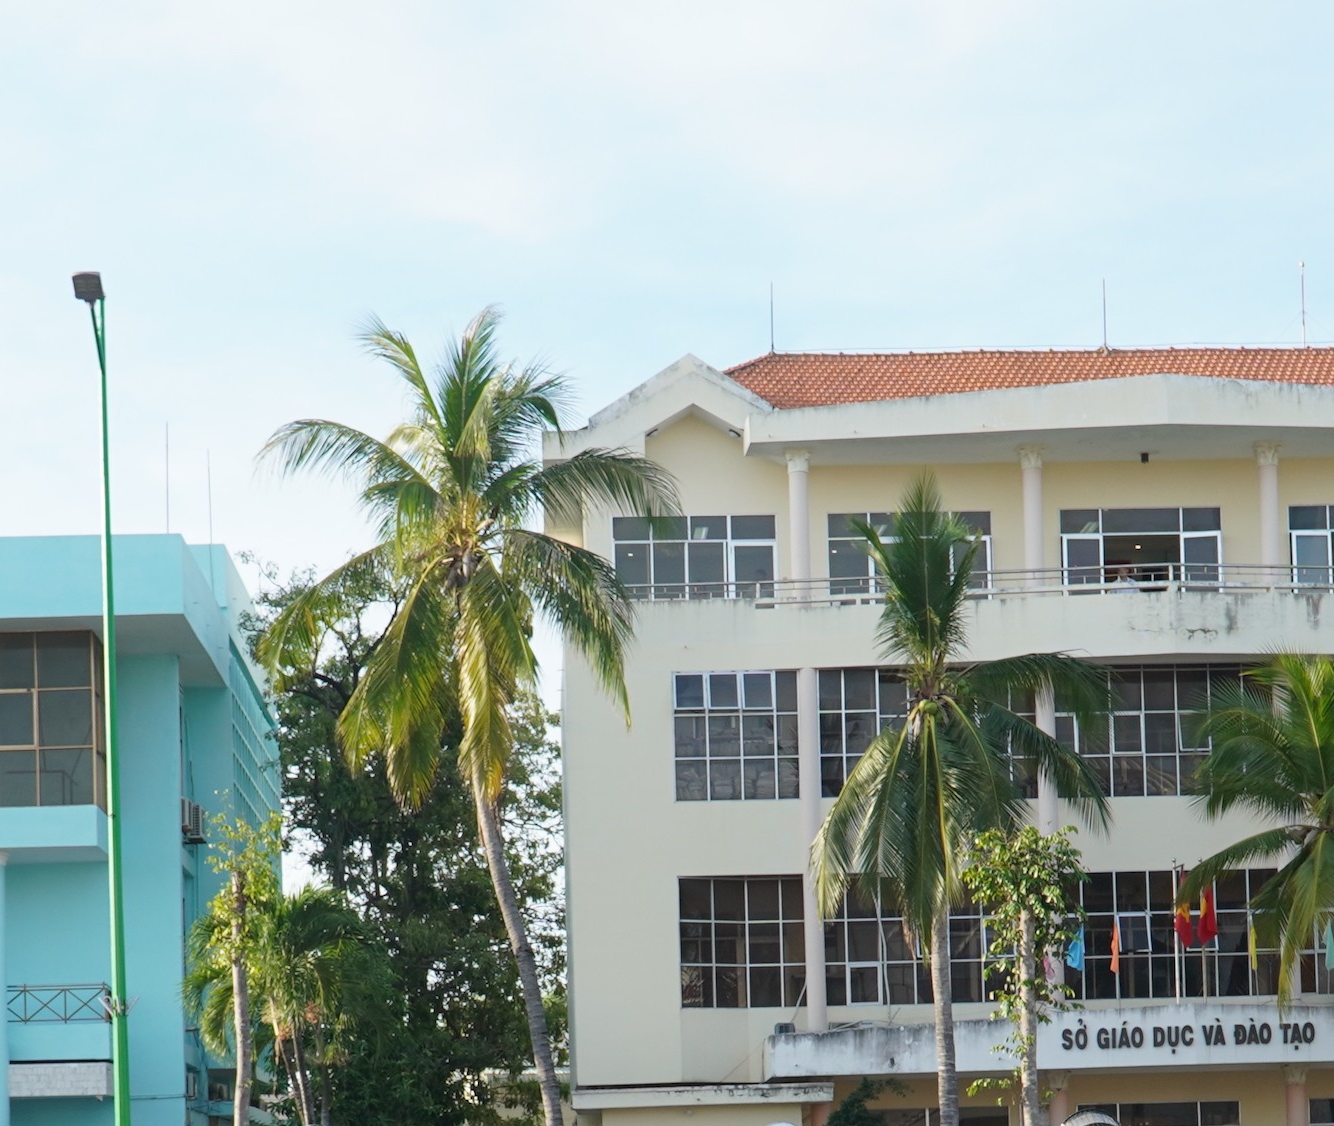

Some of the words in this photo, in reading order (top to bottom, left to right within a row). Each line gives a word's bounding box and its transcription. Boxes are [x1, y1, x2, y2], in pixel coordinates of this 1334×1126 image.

[1062, 1018, 1088, 1050] SỞ
[1097, 1021, 1144, 1049] GIÁO
[1153, 1025, 1194, 1054] DỤC
[1202, 1018, 1226, 1045] VÀ
[1234, 1018, 1272, 1045] ĐÀO
[1280, 1022, 1315, 1050] TẠO
